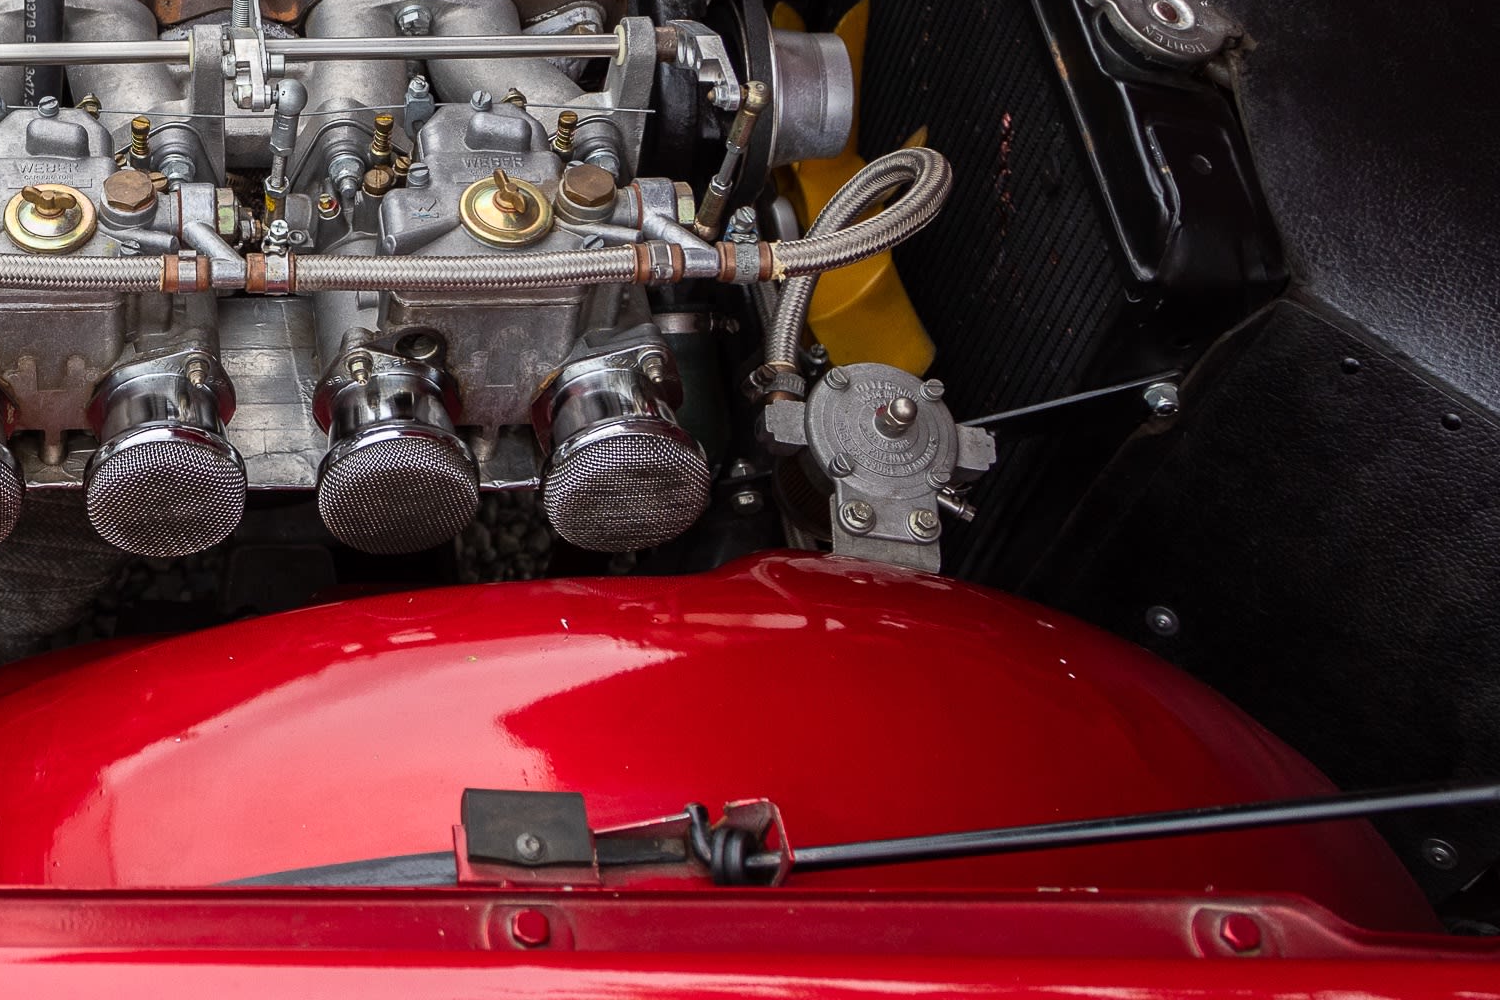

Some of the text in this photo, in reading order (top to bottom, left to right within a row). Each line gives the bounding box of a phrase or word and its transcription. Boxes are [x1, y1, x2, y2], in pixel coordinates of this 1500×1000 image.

[1143, 25, 1210, 53] TIGHTEN
[19, 162, 79, 174] WEBER
[461, 157, 524, 169] WEBER
